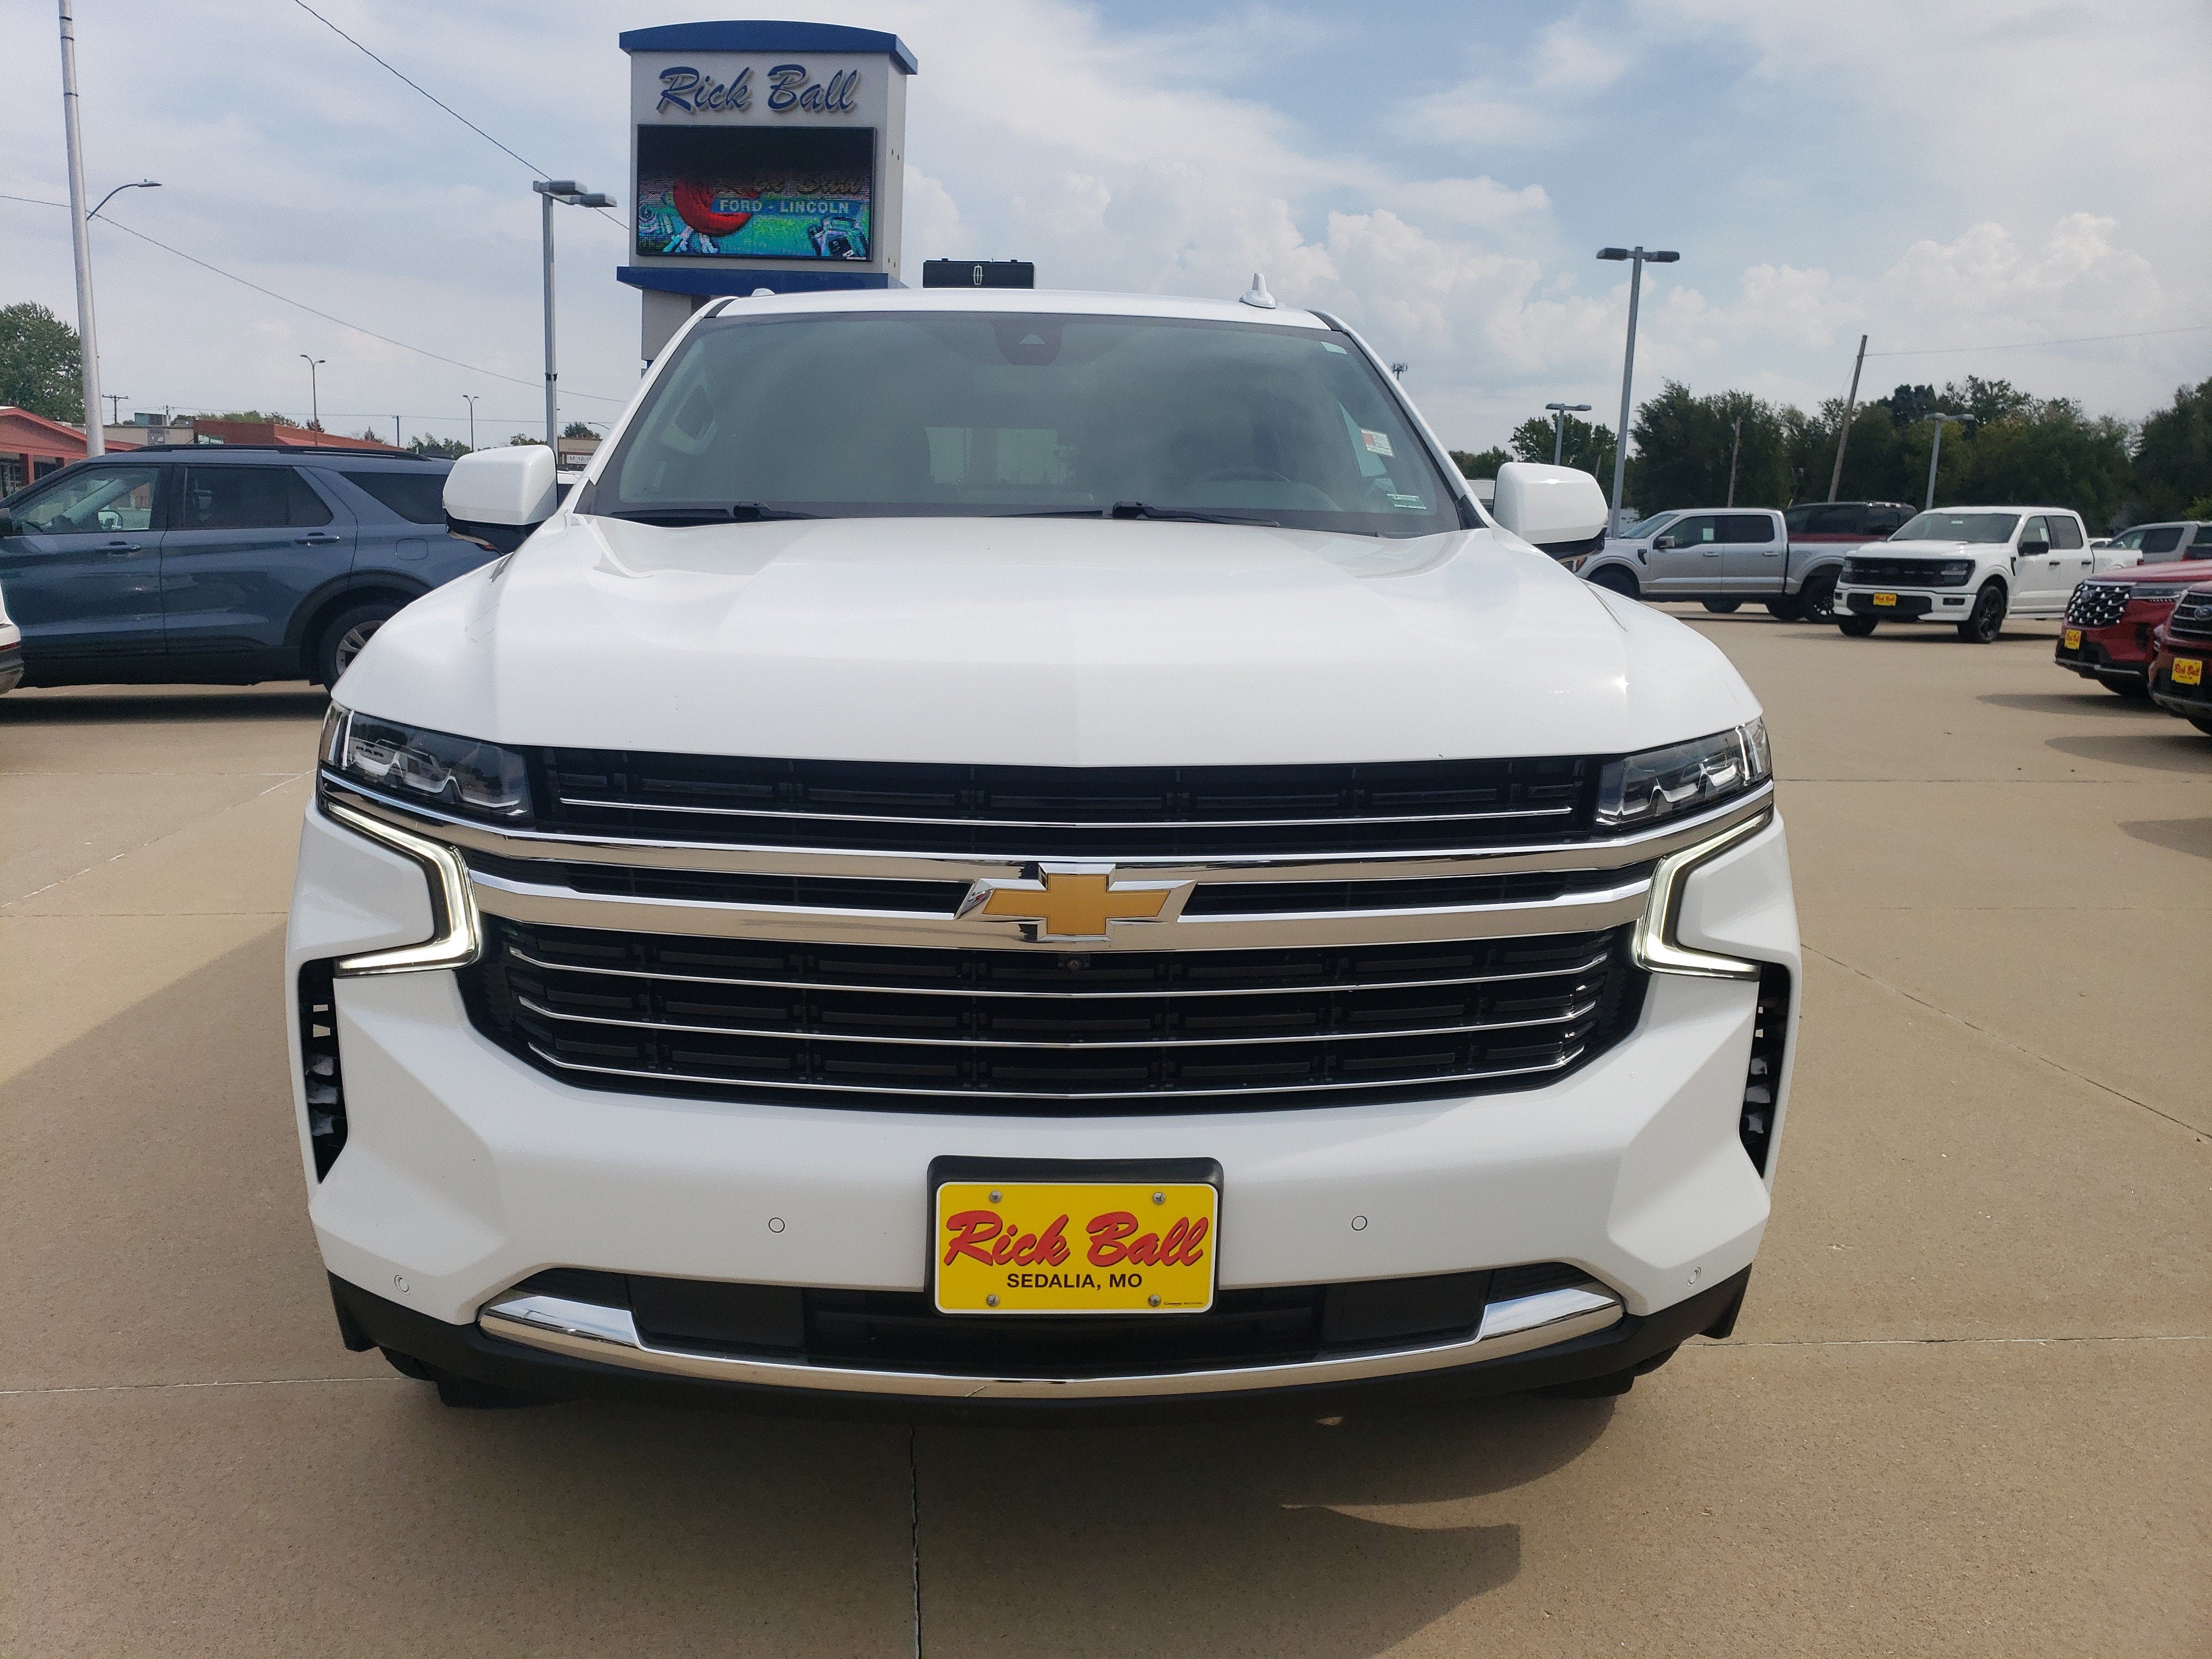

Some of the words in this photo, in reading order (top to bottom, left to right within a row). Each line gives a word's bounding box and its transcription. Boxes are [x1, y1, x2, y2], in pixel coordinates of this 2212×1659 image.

[656, 66, 752, 113] Rick
[767, 64, 860, 113] Ball
[720, 199, 763, 212] FORD
[780, 200, 849, 213] LINCOLN
[944, 1210, 1070, 1267] Rick
[1086, 1211, 1209, 1267] Ball
[1006, 1273, 1101, 1290] SEDALIA,
[1109, 1273, 1143, 1288] MO
